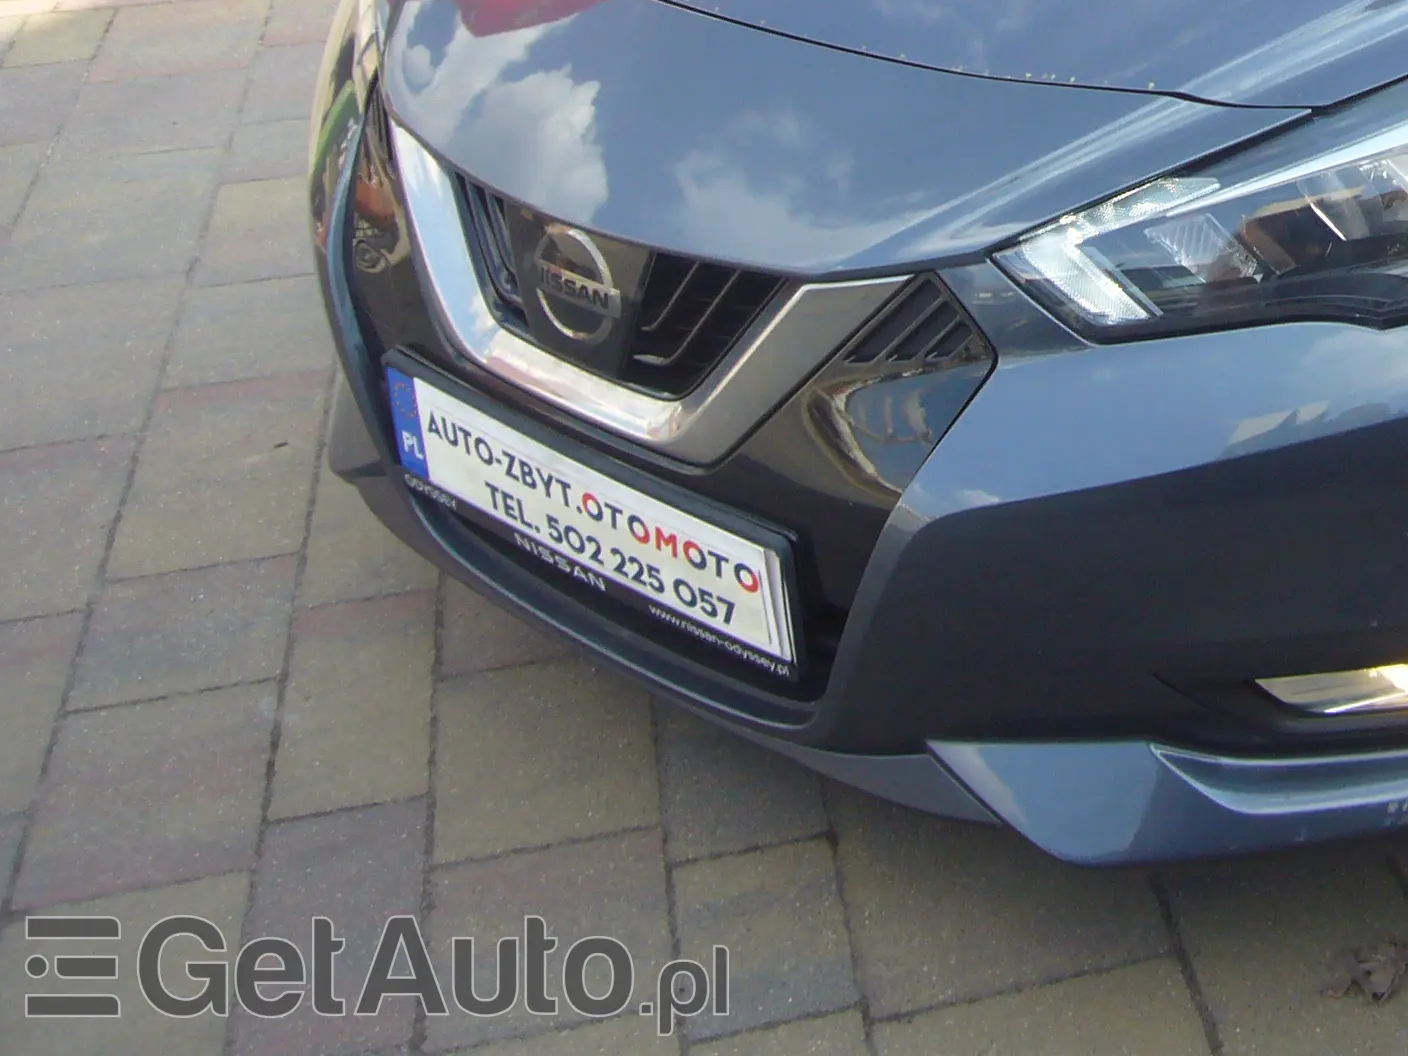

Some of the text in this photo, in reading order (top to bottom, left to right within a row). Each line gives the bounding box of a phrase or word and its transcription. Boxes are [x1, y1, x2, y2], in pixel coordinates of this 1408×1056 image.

[401, 430, 425, 461] PL
[484, 480, 736, 626] TEL. 502 225 057
[513, 531, 607, 592] NISSAN
